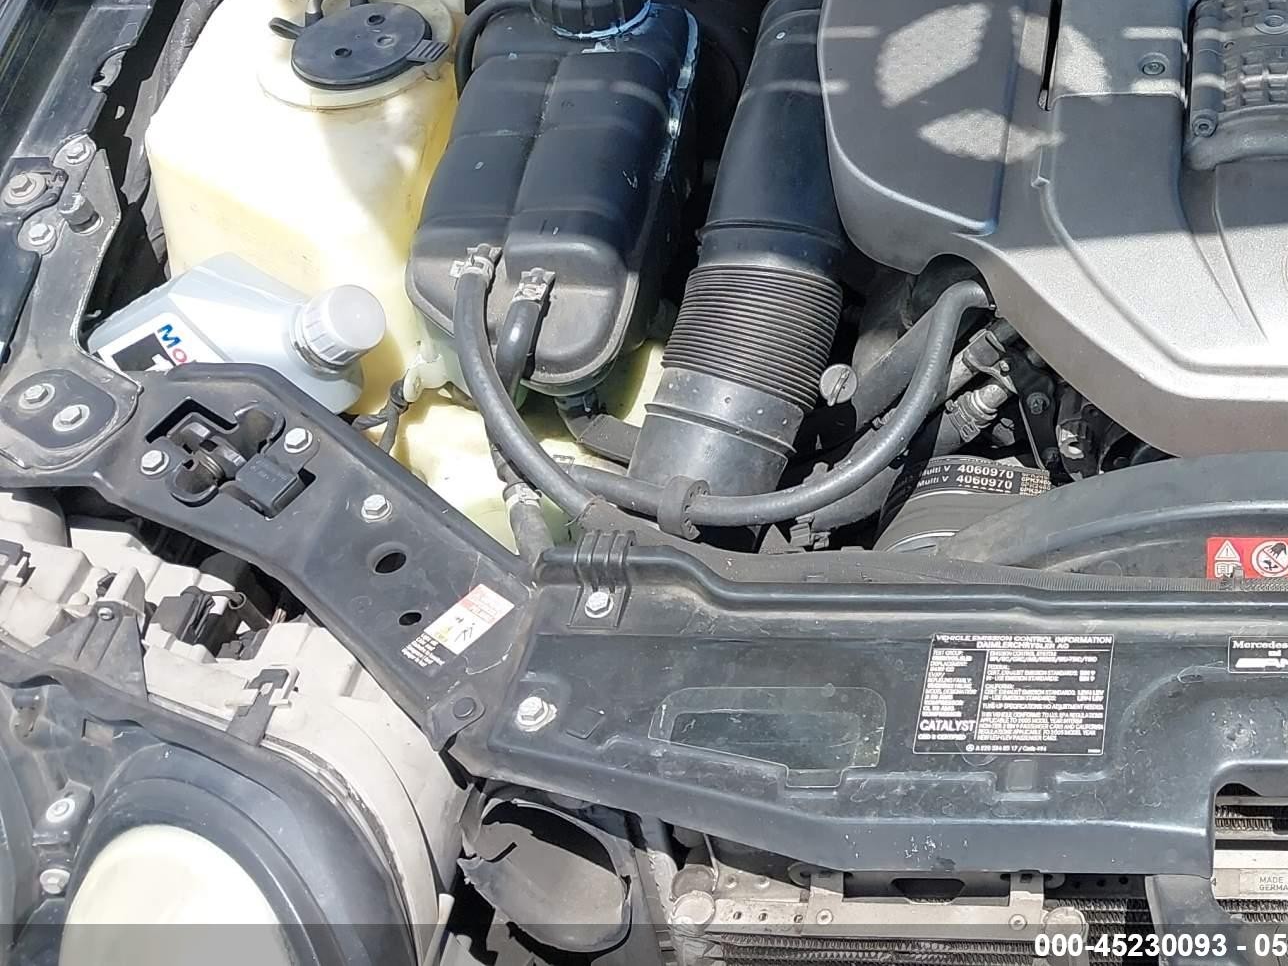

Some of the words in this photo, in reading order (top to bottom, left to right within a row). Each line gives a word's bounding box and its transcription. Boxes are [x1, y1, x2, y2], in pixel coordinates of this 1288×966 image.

[957, 464, 1014, 479] 4060970
[955, 474, 1013, 490] 4060970
[936, 634, 971, 643] VEHICLE
[1013, 635, 1052, 643] CONTROL
[1054, 636, 1113, 644] INFORMATION
[919, 718, 977, 732] CATALYST
